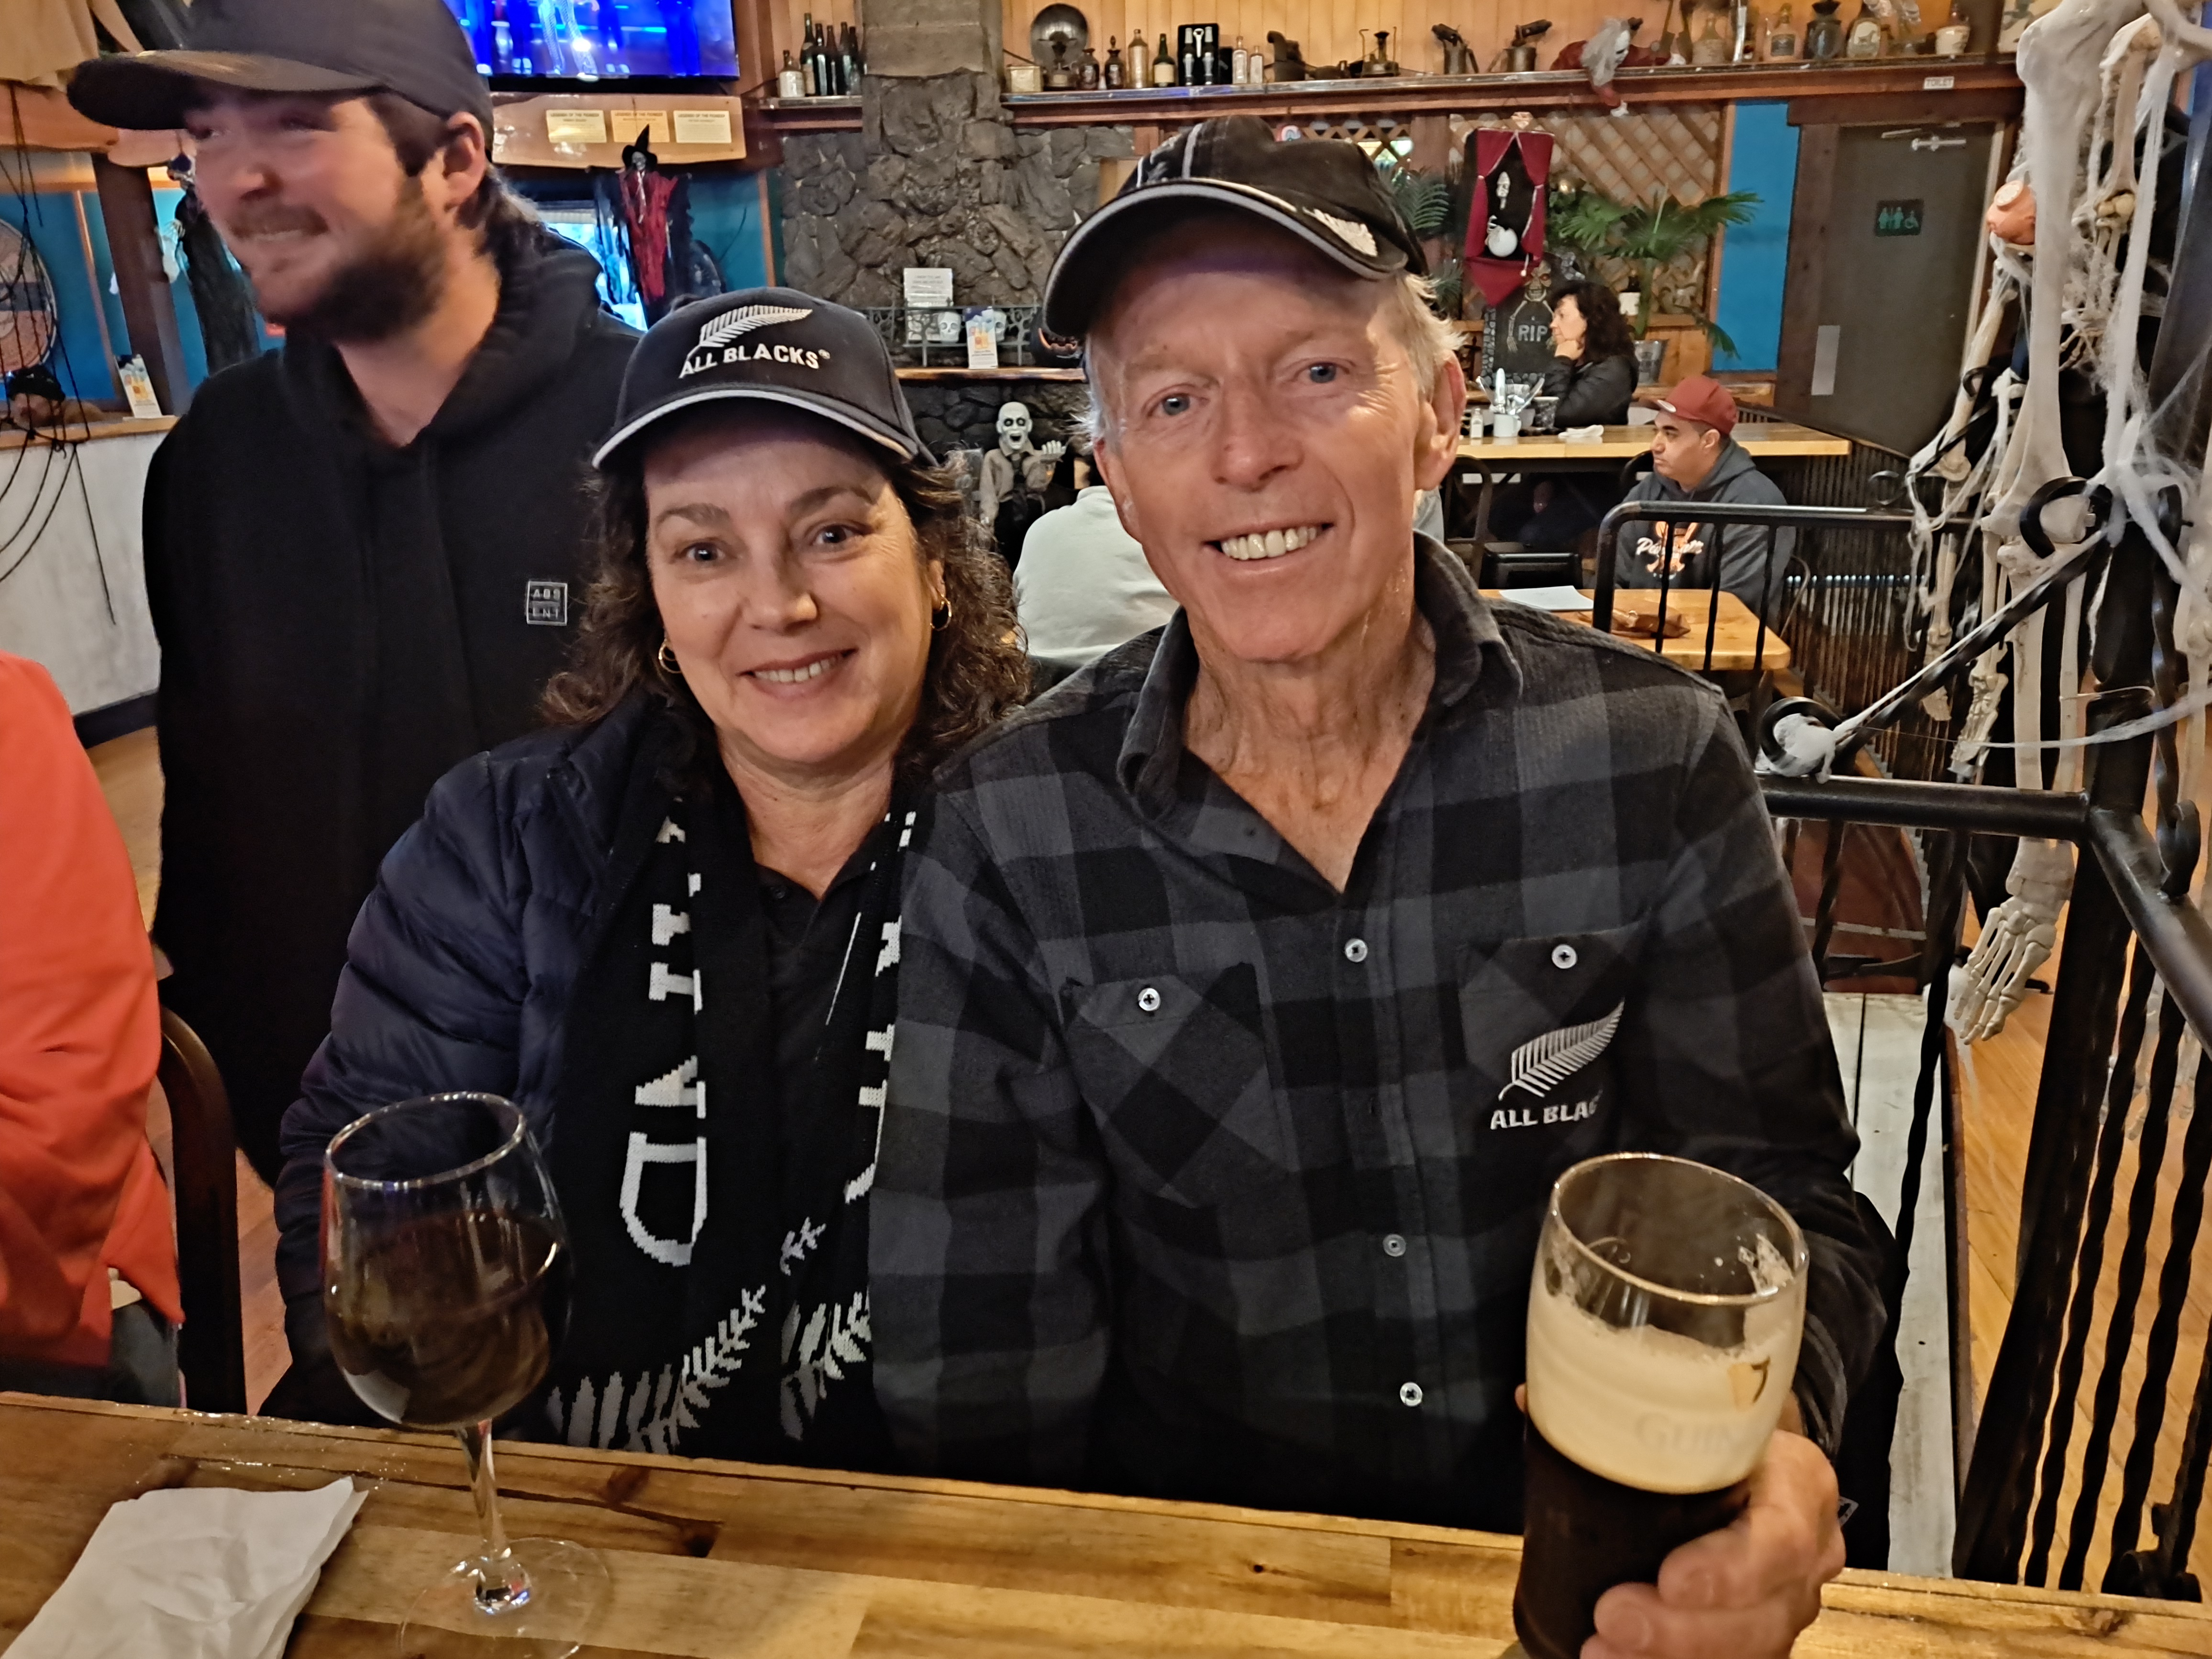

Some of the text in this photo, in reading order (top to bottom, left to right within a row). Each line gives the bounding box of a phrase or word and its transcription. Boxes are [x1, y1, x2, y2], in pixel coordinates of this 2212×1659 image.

[1518, 324, 1548, 342] RIP
[678, 353, 718, 379] ALL
[1490, 1109, 1538, 1130] ALL
